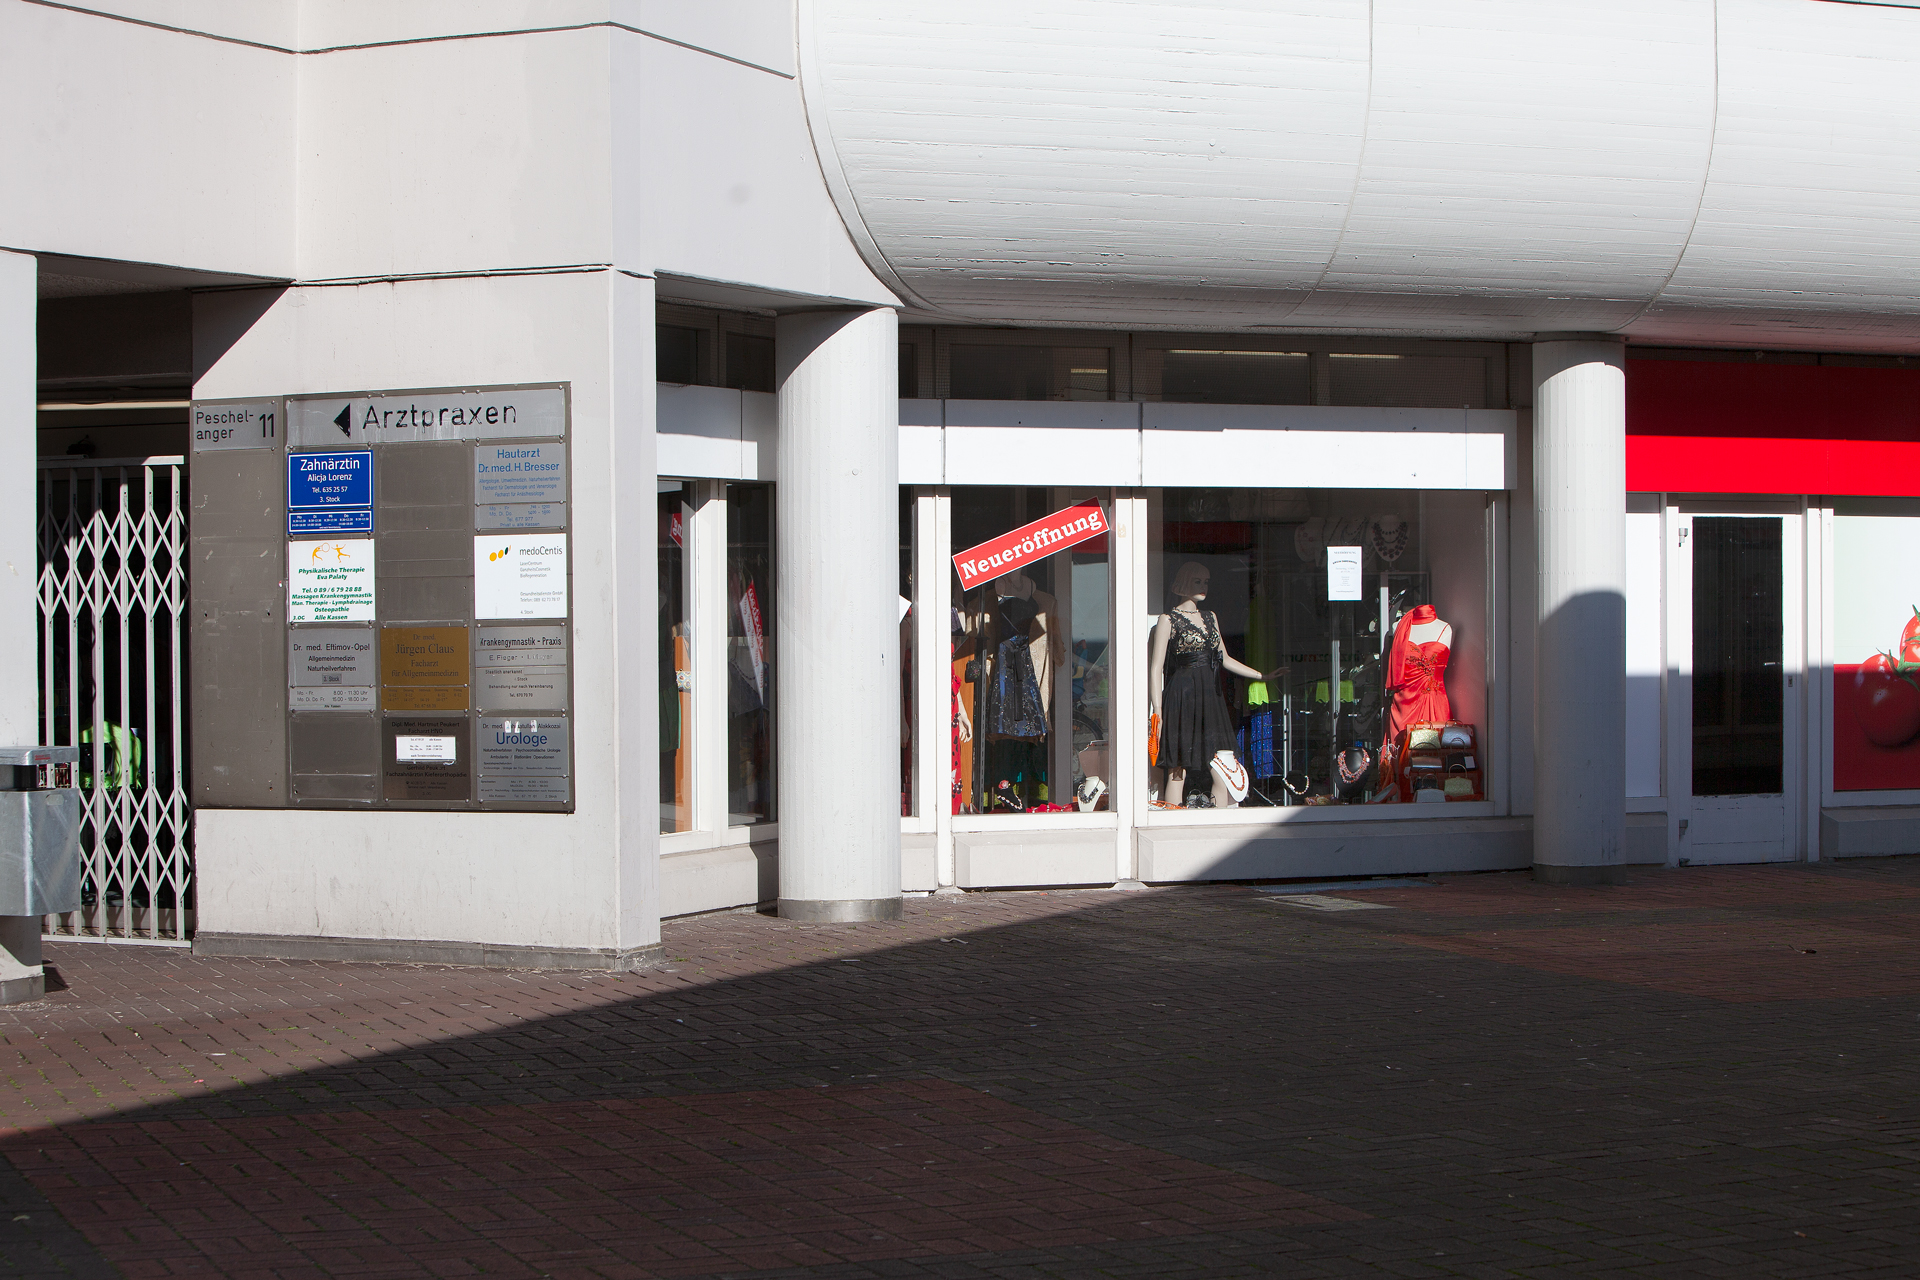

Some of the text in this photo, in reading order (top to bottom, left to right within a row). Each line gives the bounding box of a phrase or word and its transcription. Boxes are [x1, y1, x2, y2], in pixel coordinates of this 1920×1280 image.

[196, 410, 254, 424] Peschel-
[362, 404, 517, 434] Arztpraxen
[259, 413, 275, 438] 11
[196, 428, 235, 443] anger
[497, 448, 540, 459] Hautarzt
[300, 457, 360, 471] Zahnärztin
[478, 462, 560, 473] Dr. med. H. Bresser
[307, 473, 353, 484] Alicja Lorenz
[520, 546, 563, 556] medoCentis
[960, 511, 1102, 580] Neueröffnung
[298, 566, 365, 575] Physikalische Therapie
[542, 636, 562, 646] Praxis
[293, 643, 303, 651] Dr.
[325, 642, 371, 652] Eftimov-Opel
[395, 643, 455, 656] Jürgen Claus
[410, 659, 439, 667] Facharzt
[401, 669, 459, 678] Allgemeinmedizin
[496, 731, 548, 747] Urologe
